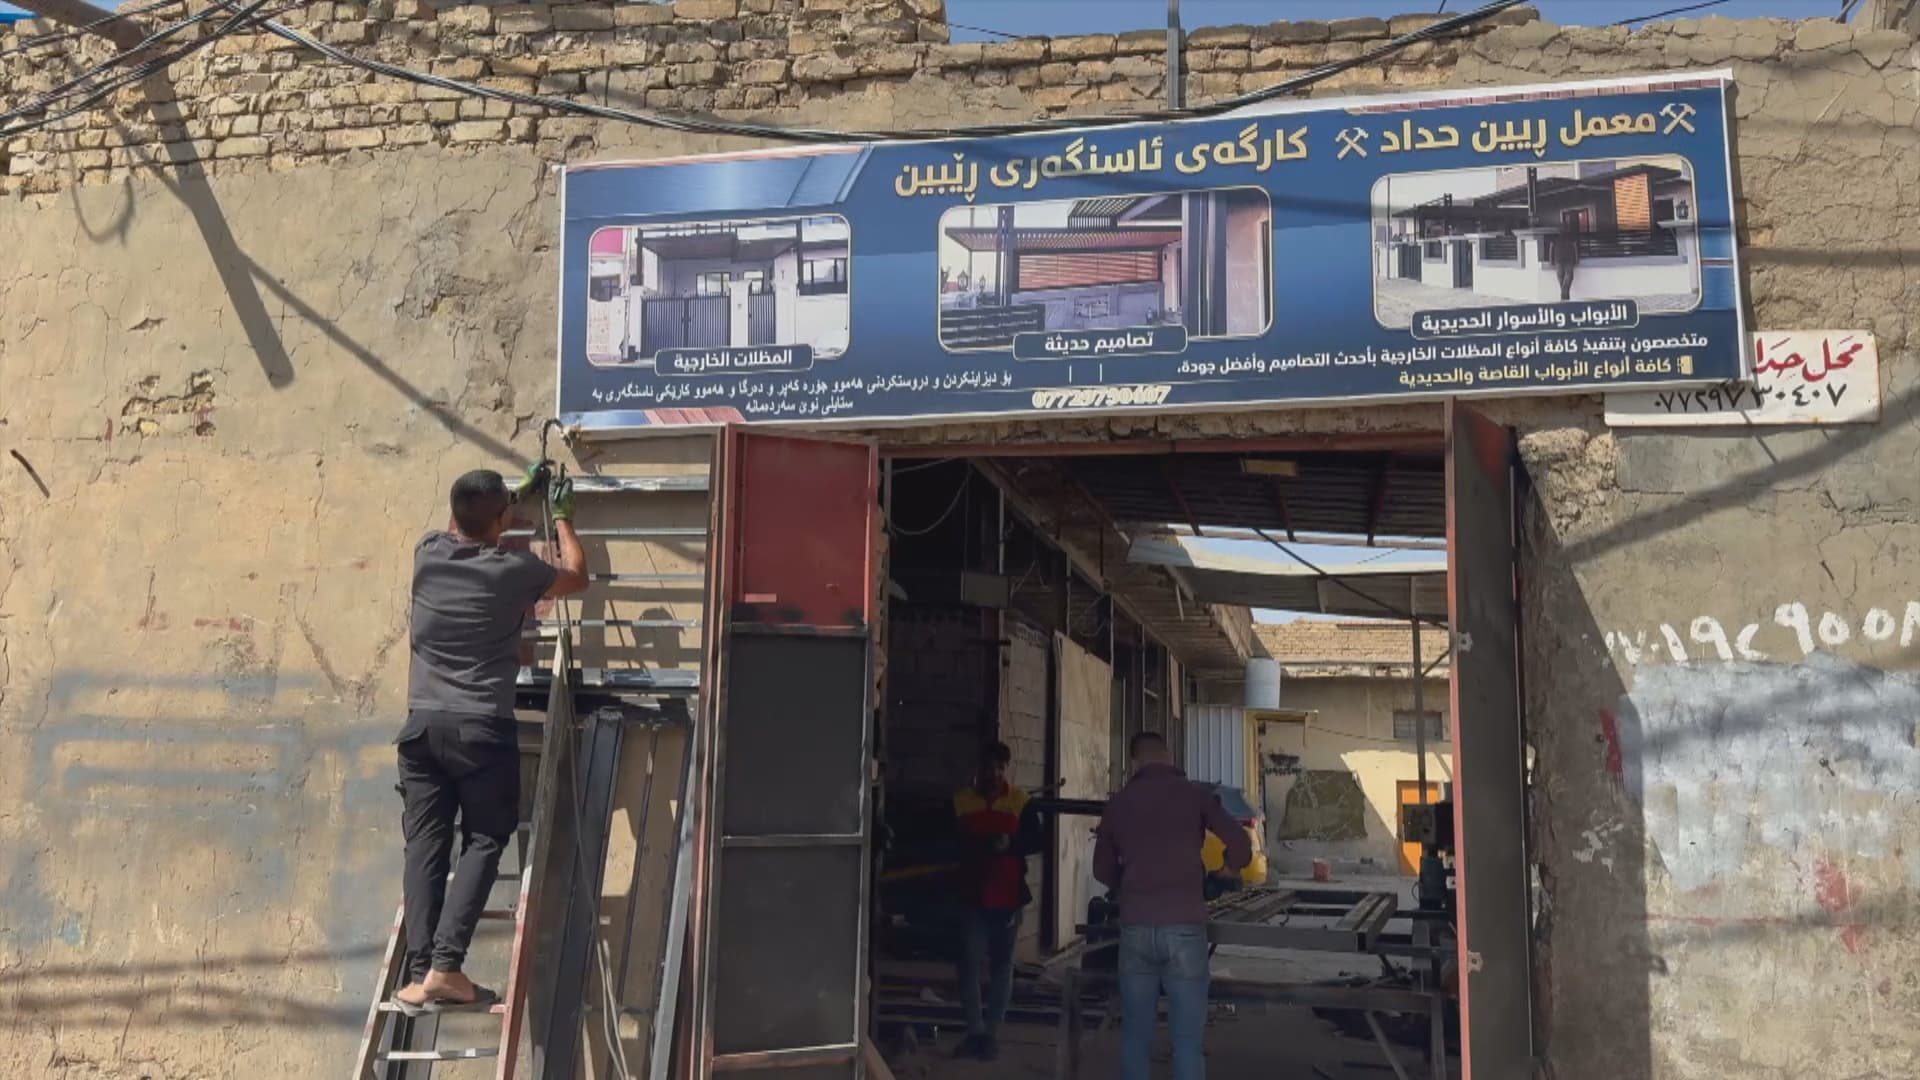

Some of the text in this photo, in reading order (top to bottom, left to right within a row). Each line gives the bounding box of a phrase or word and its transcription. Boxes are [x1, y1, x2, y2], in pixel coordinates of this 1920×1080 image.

[1379, 119, 1460, 153] حداد
[1559, 108, 1656, 147] معمل
[1421, 304, 1628, 334] الأبواب والأسوار الحديدية
[1045, 331, 1154, 355] تصاميم حديثة
[1441, 343, 1501, 360] المظلات
[1505, 336, 1540, 359] أنواع
[1543, 337, 1579, 354] كافة
[1581, 338, 1627, 356] بتنفيذ
[1630, 333, 1708, 353] متخصصون
[673, 349, 792, 373] المظلات الخارجية
[1219, 353, 1265, 374] وأفضل
[1269, 353, 1330, 373] التصاميم
[1333, 346, 1376, 367] بأحدث
[1381, 346, 1436, 366] الخارجية
[1635, 357, 1672, 374] كافة
[1535, 360, 1589, 380] الأبواب
[1594, 355, 1631, 379] أنواع
[1399, 368, 1474, 389] والحديدية
